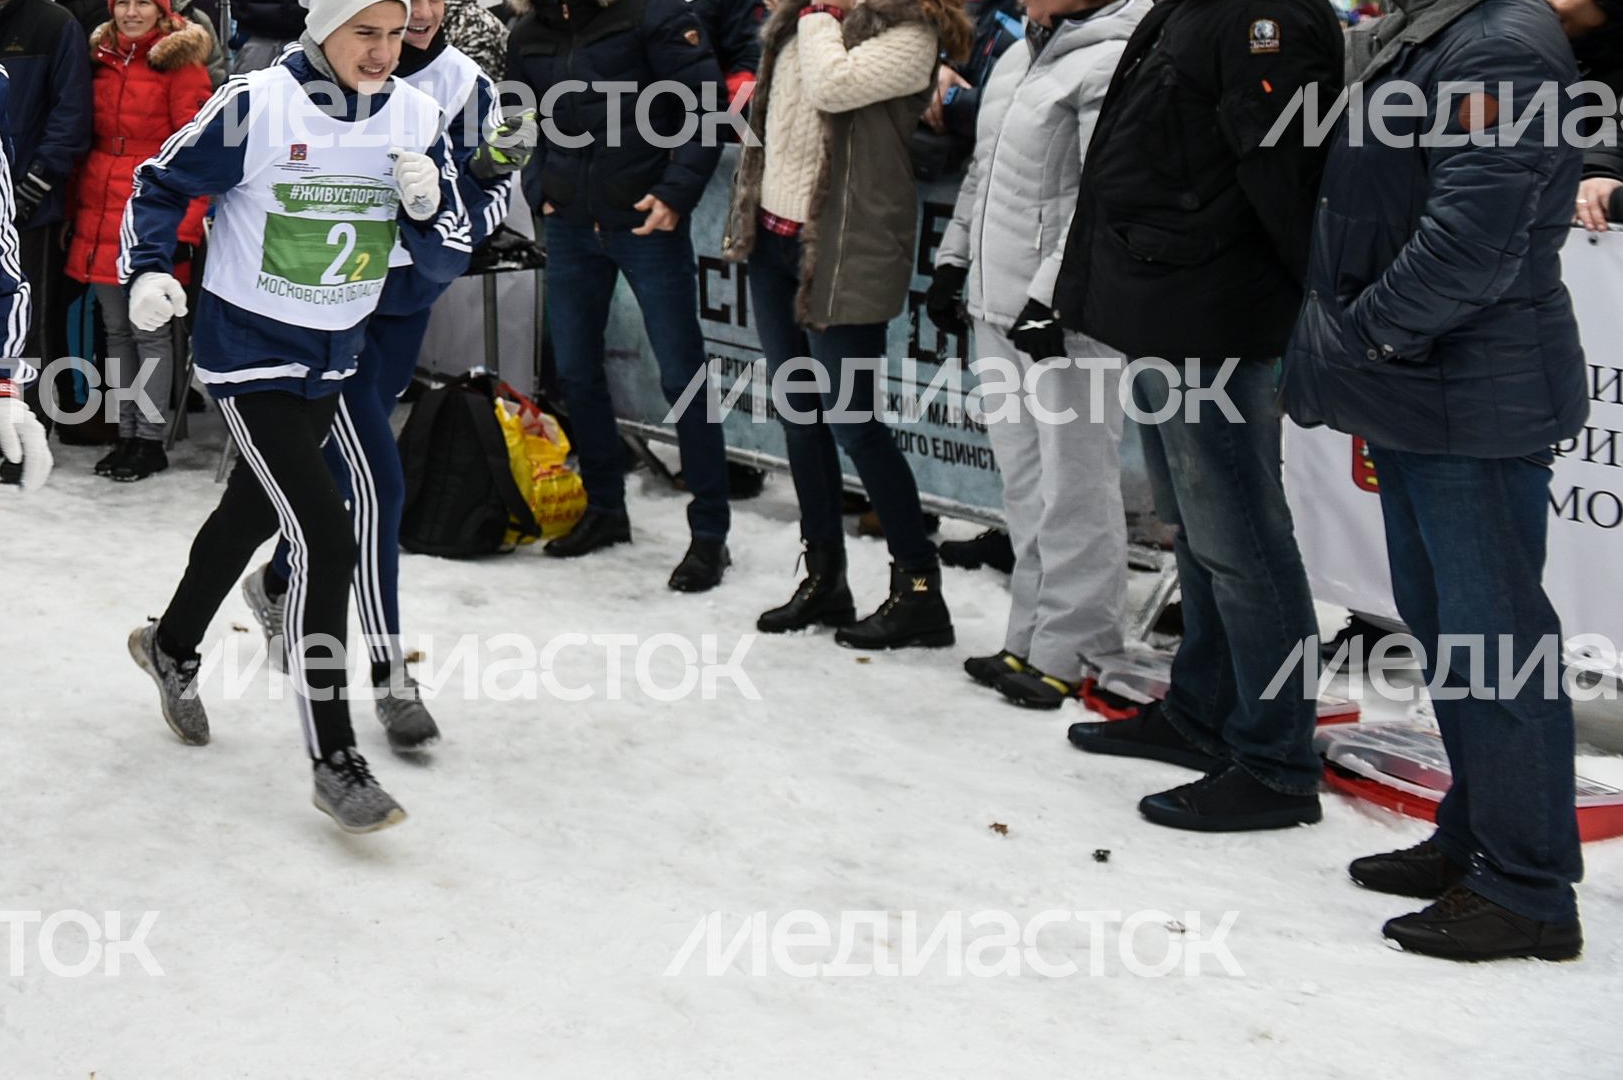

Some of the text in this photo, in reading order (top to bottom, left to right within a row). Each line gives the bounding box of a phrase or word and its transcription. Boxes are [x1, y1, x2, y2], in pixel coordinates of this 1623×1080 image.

[320, 222, 371, 285] 2 2
[256, 275, 344, 306] МОСКОВСКАЯ
[927, 400, 988, 435] МАРАФ
[931, 437, 1002, 473] ЕДИНСТ
